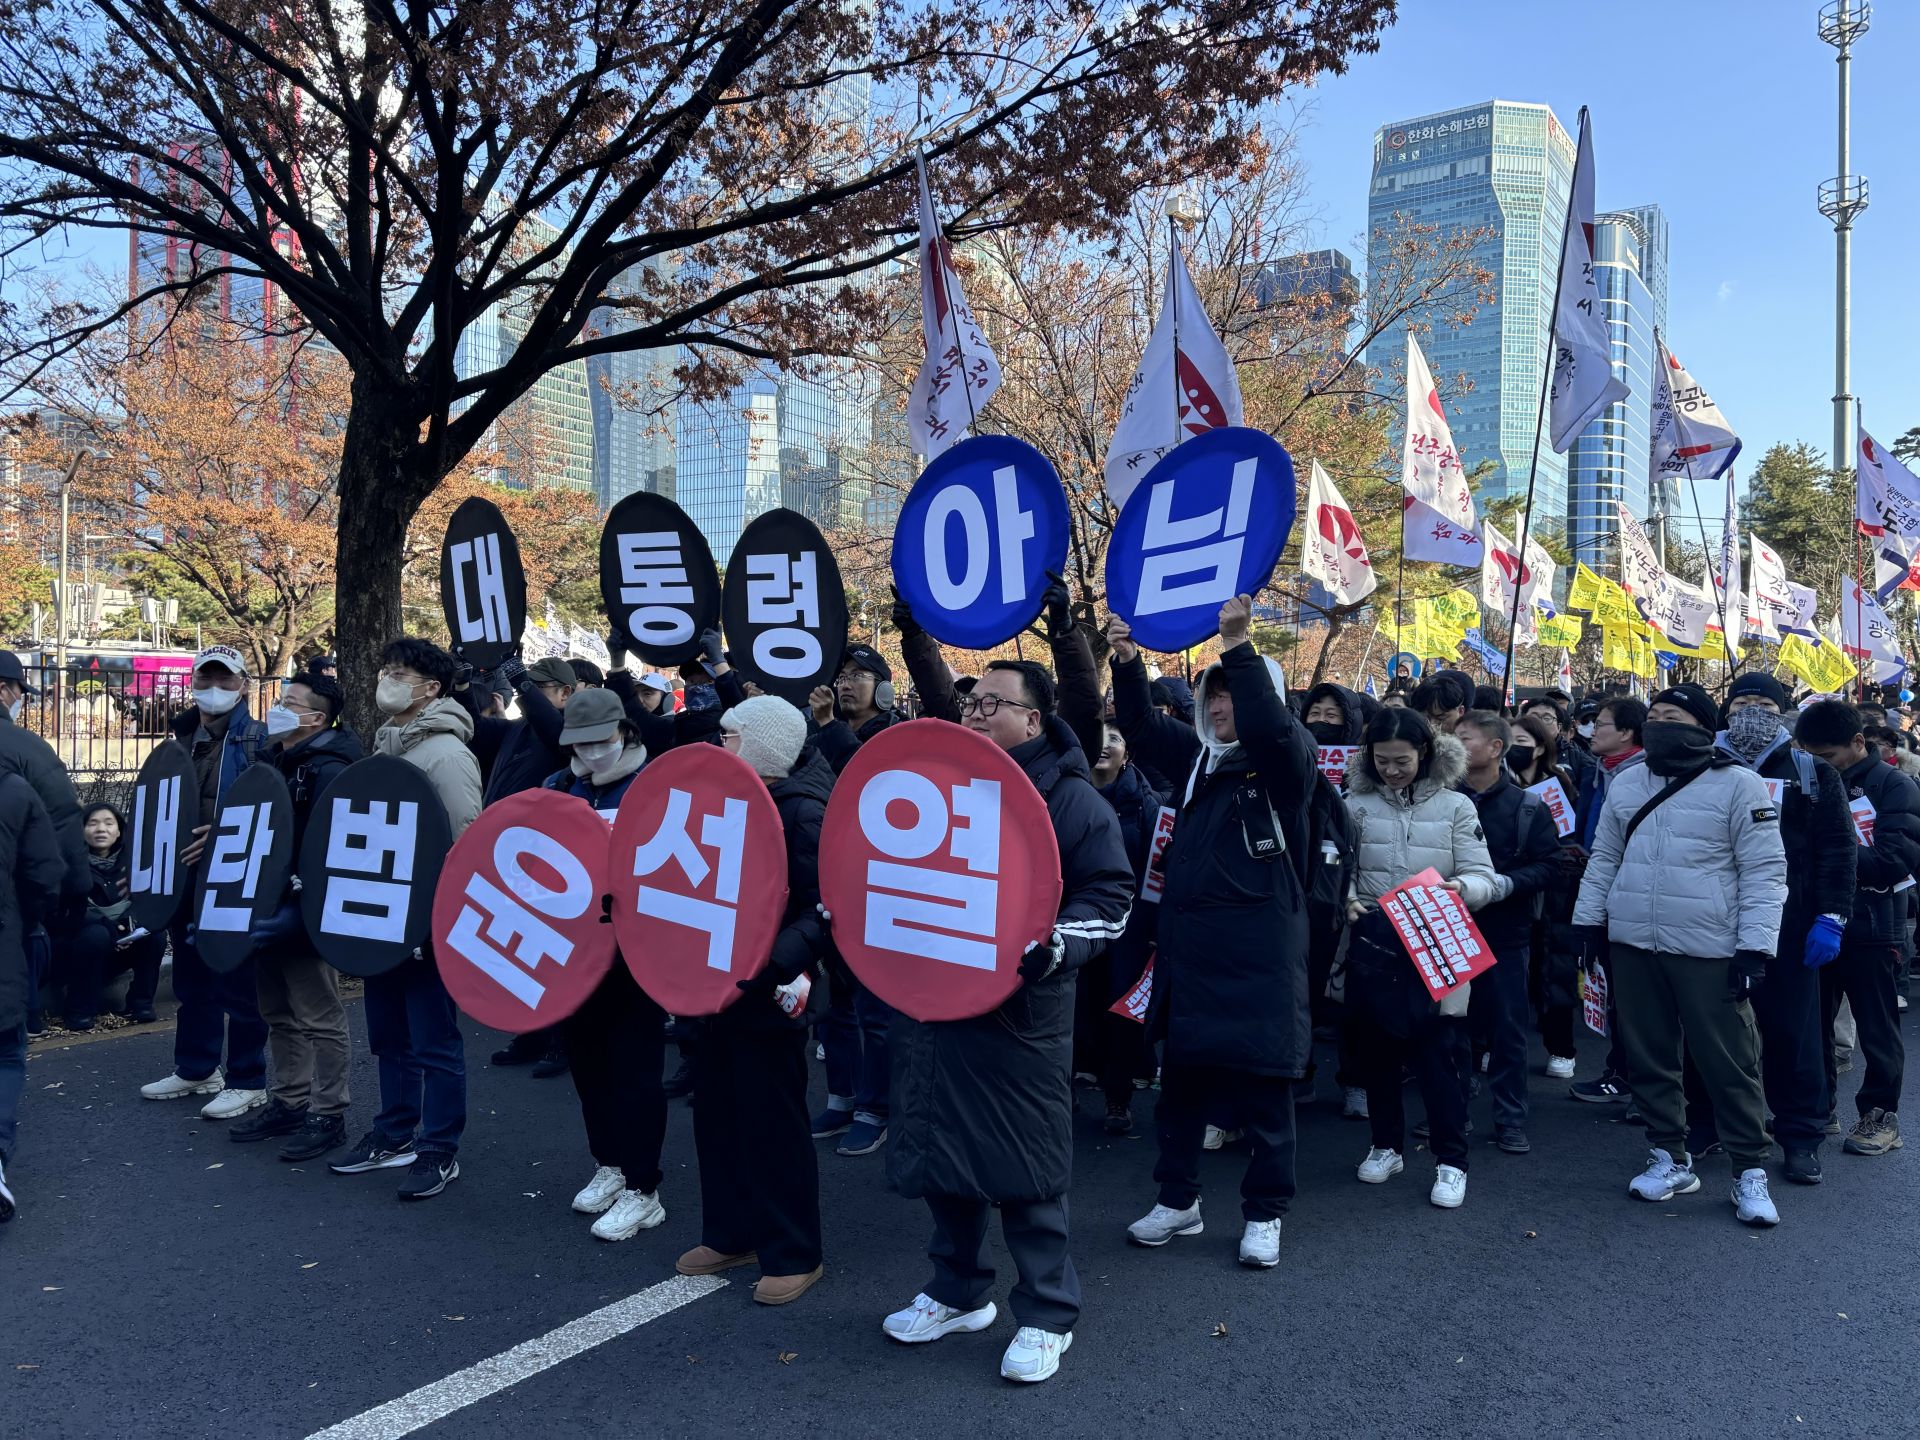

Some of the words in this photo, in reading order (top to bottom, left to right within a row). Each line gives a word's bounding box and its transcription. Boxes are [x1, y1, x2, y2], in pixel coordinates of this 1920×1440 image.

[1408, 113, 1490, 144] 한화손해보험
[451, 533, 510, 642] 대
[618, 532, 694, 645] 통
[924, 465, 1034, 610] 아
[1134, 457, 1257, 616] 님
[201, 646, 237, 660] JACKIE
[747, 552, 822, 678] 령
[132, 776, 180, 894] 내
[199, 802, 274, 931] 란
[321, 798, 418, 943] 범
[634, 788, 748, 972] 석
[859, 770, 1000, 971] 열
[447, 827, 592, 1009] 윤
[1408, 884, 1472, 973] 사회대개혁
[1415, 949, 1445, 989] 윤석열
